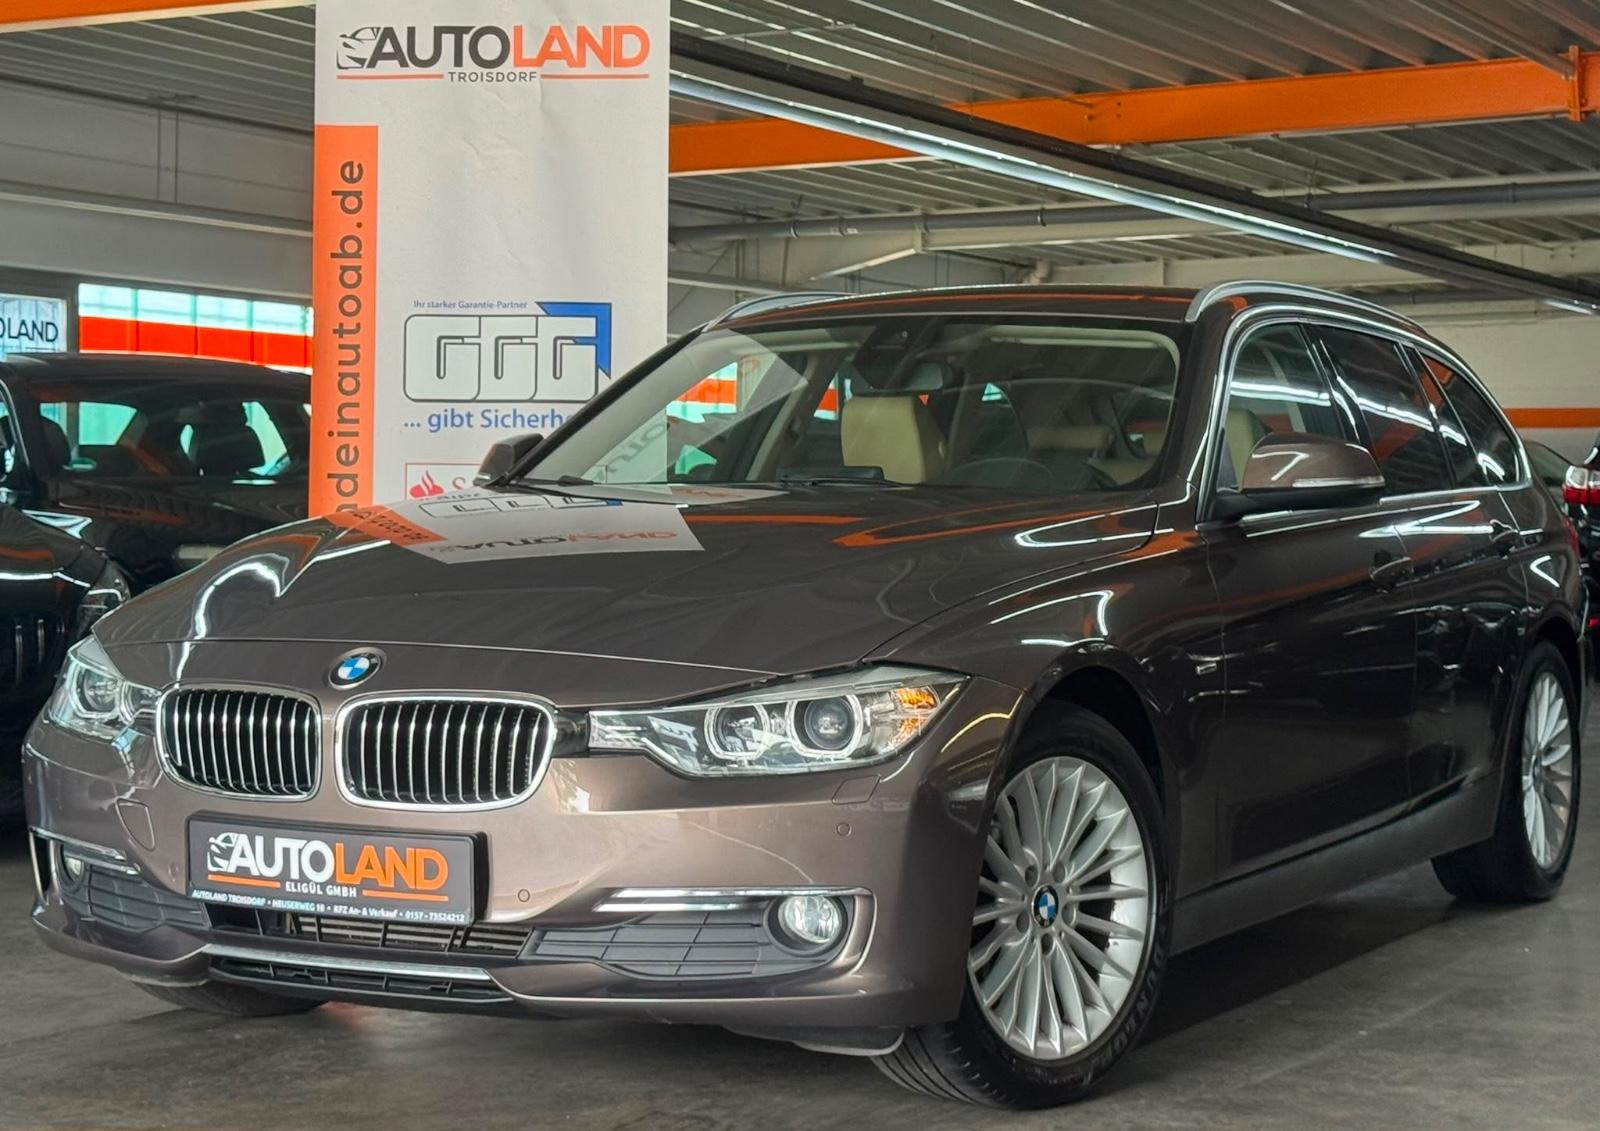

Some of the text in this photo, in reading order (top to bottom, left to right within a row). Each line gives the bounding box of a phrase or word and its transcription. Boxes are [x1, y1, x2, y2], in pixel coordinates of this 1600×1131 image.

[367, 25, 650, 69] AUTOLAND
[448, 71, 538, 83] TROISDORF
[413, 300, 425, 309] Ihr
[427, 300, 456, 309] starker
[428, 409, 474, 432] gibt
[480, 408, 571, 428] Sicherh
[227, 832, 449, 891] AUTOLAND
[285, 881, 357, 898] ELIGÜL GMBH
[191, 889, 228, 902] AUTOLAND
[228, 893, 266, 906] TROISDORF
[272, 899, 315, 911] HEUSERWEG
[333, 904, 348, 914] KFZ
[368, 907, 398, 917] Verkauf
[405, 910, 423, 920] 0157
